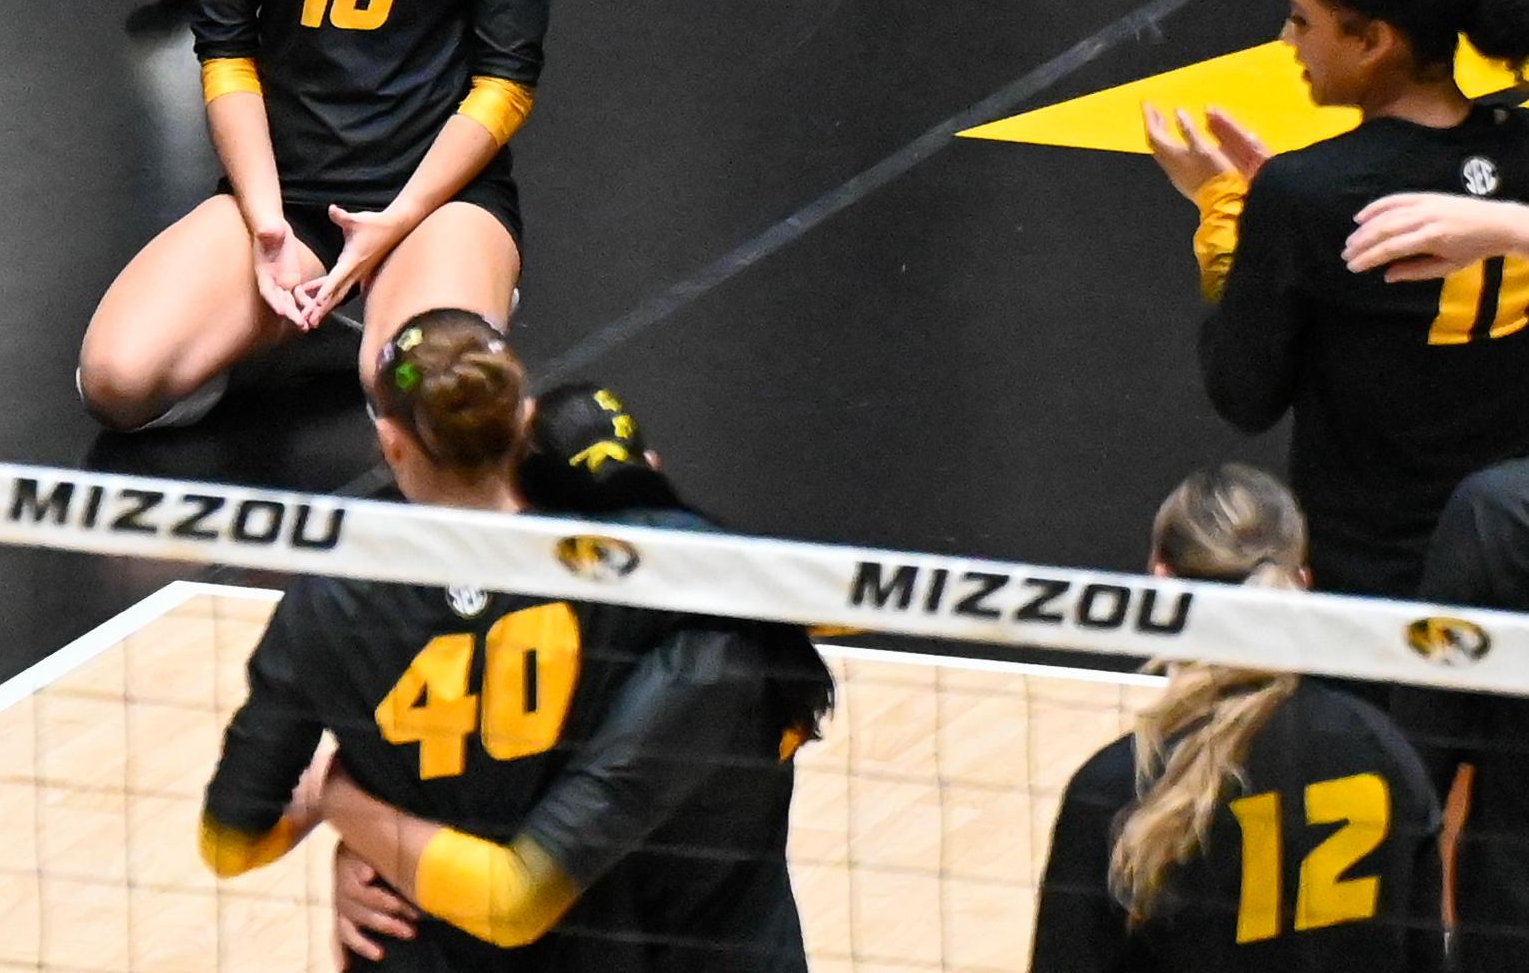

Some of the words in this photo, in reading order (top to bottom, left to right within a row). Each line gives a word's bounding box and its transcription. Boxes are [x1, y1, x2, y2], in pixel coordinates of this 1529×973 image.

[8, 477, 346, 550] MIZZOU
[848, 560, 1194, 635] MIZZOU
[375, 602, 581, 781] 40
[1229, 771, 1390, 944] 12
